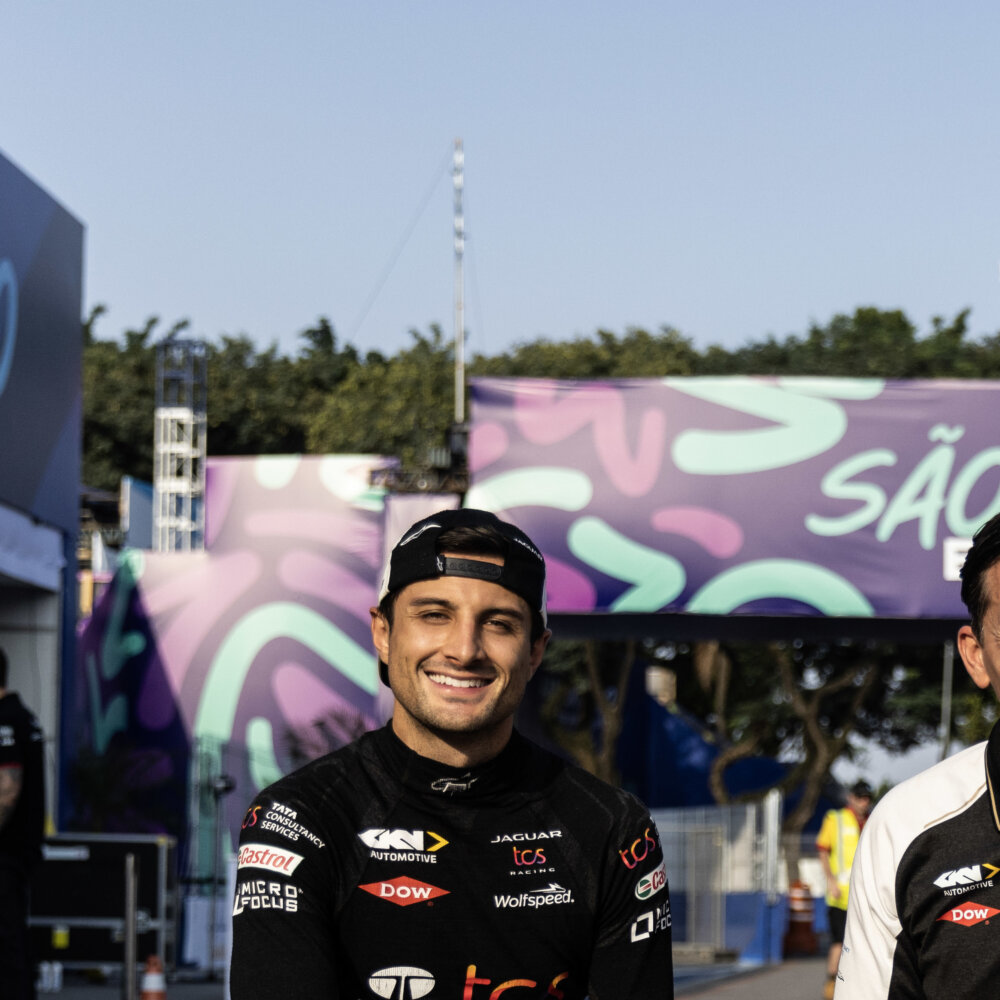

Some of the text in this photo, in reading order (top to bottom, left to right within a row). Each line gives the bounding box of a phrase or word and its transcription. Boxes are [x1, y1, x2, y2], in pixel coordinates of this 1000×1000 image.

[271, 802, 298, 820] TATA
[260, 820, 300, 842] SERVICES
[265, 810, 325, 849] CONSULTANCY
[491, 830, 563, 844] JAGUAR
[370, 850, 437, 864] AUTOMOTIVE
[513, 846, 547, 866] tcs
[618, 827, 656, 870] tcs
[240, 847, 297, 872] Castrol
[509, 867, 556, 876] RACING
[943, 880, 994, 897] AUTOMOTIVE
